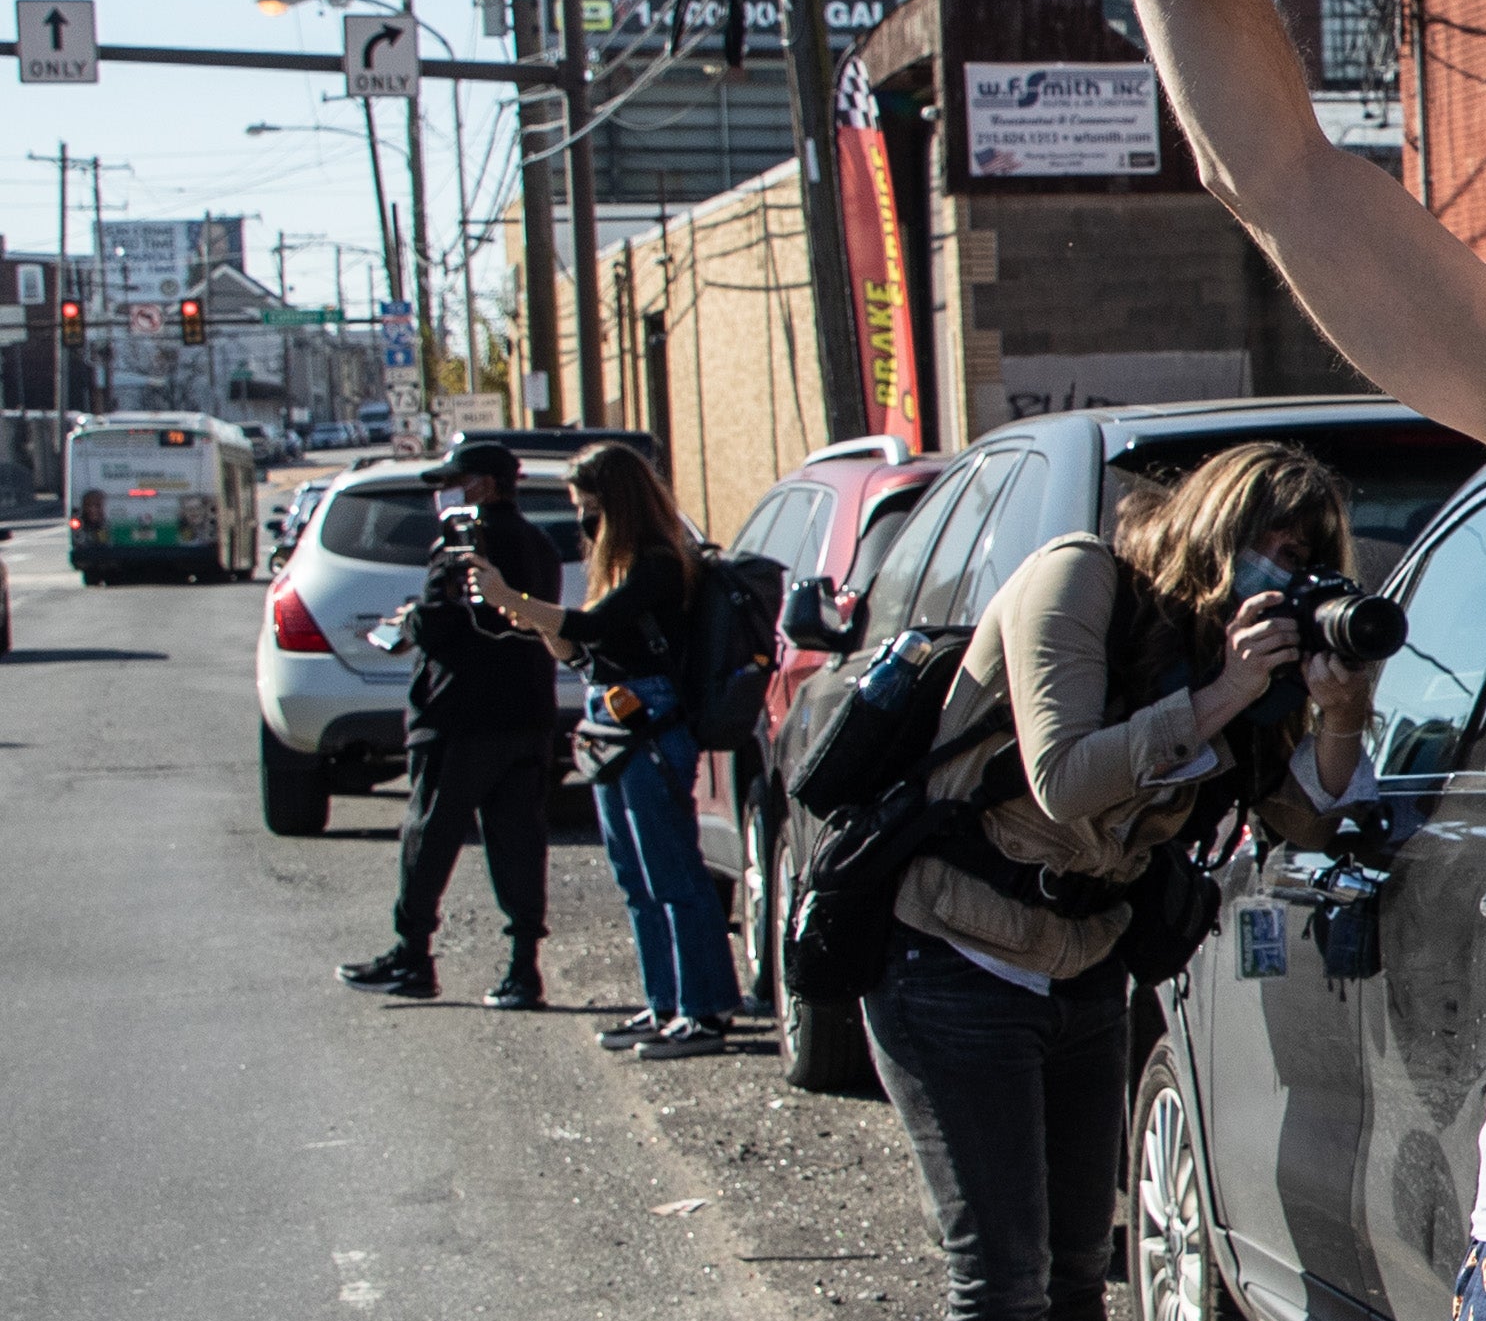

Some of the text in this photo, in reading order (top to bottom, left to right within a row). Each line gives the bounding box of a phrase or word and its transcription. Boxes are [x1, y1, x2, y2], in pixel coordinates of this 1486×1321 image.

[29, 60, 87, 78] ONLY
[355, 74, 409, 91] ONLY
[863, 279, 899, 408] BRAKE
